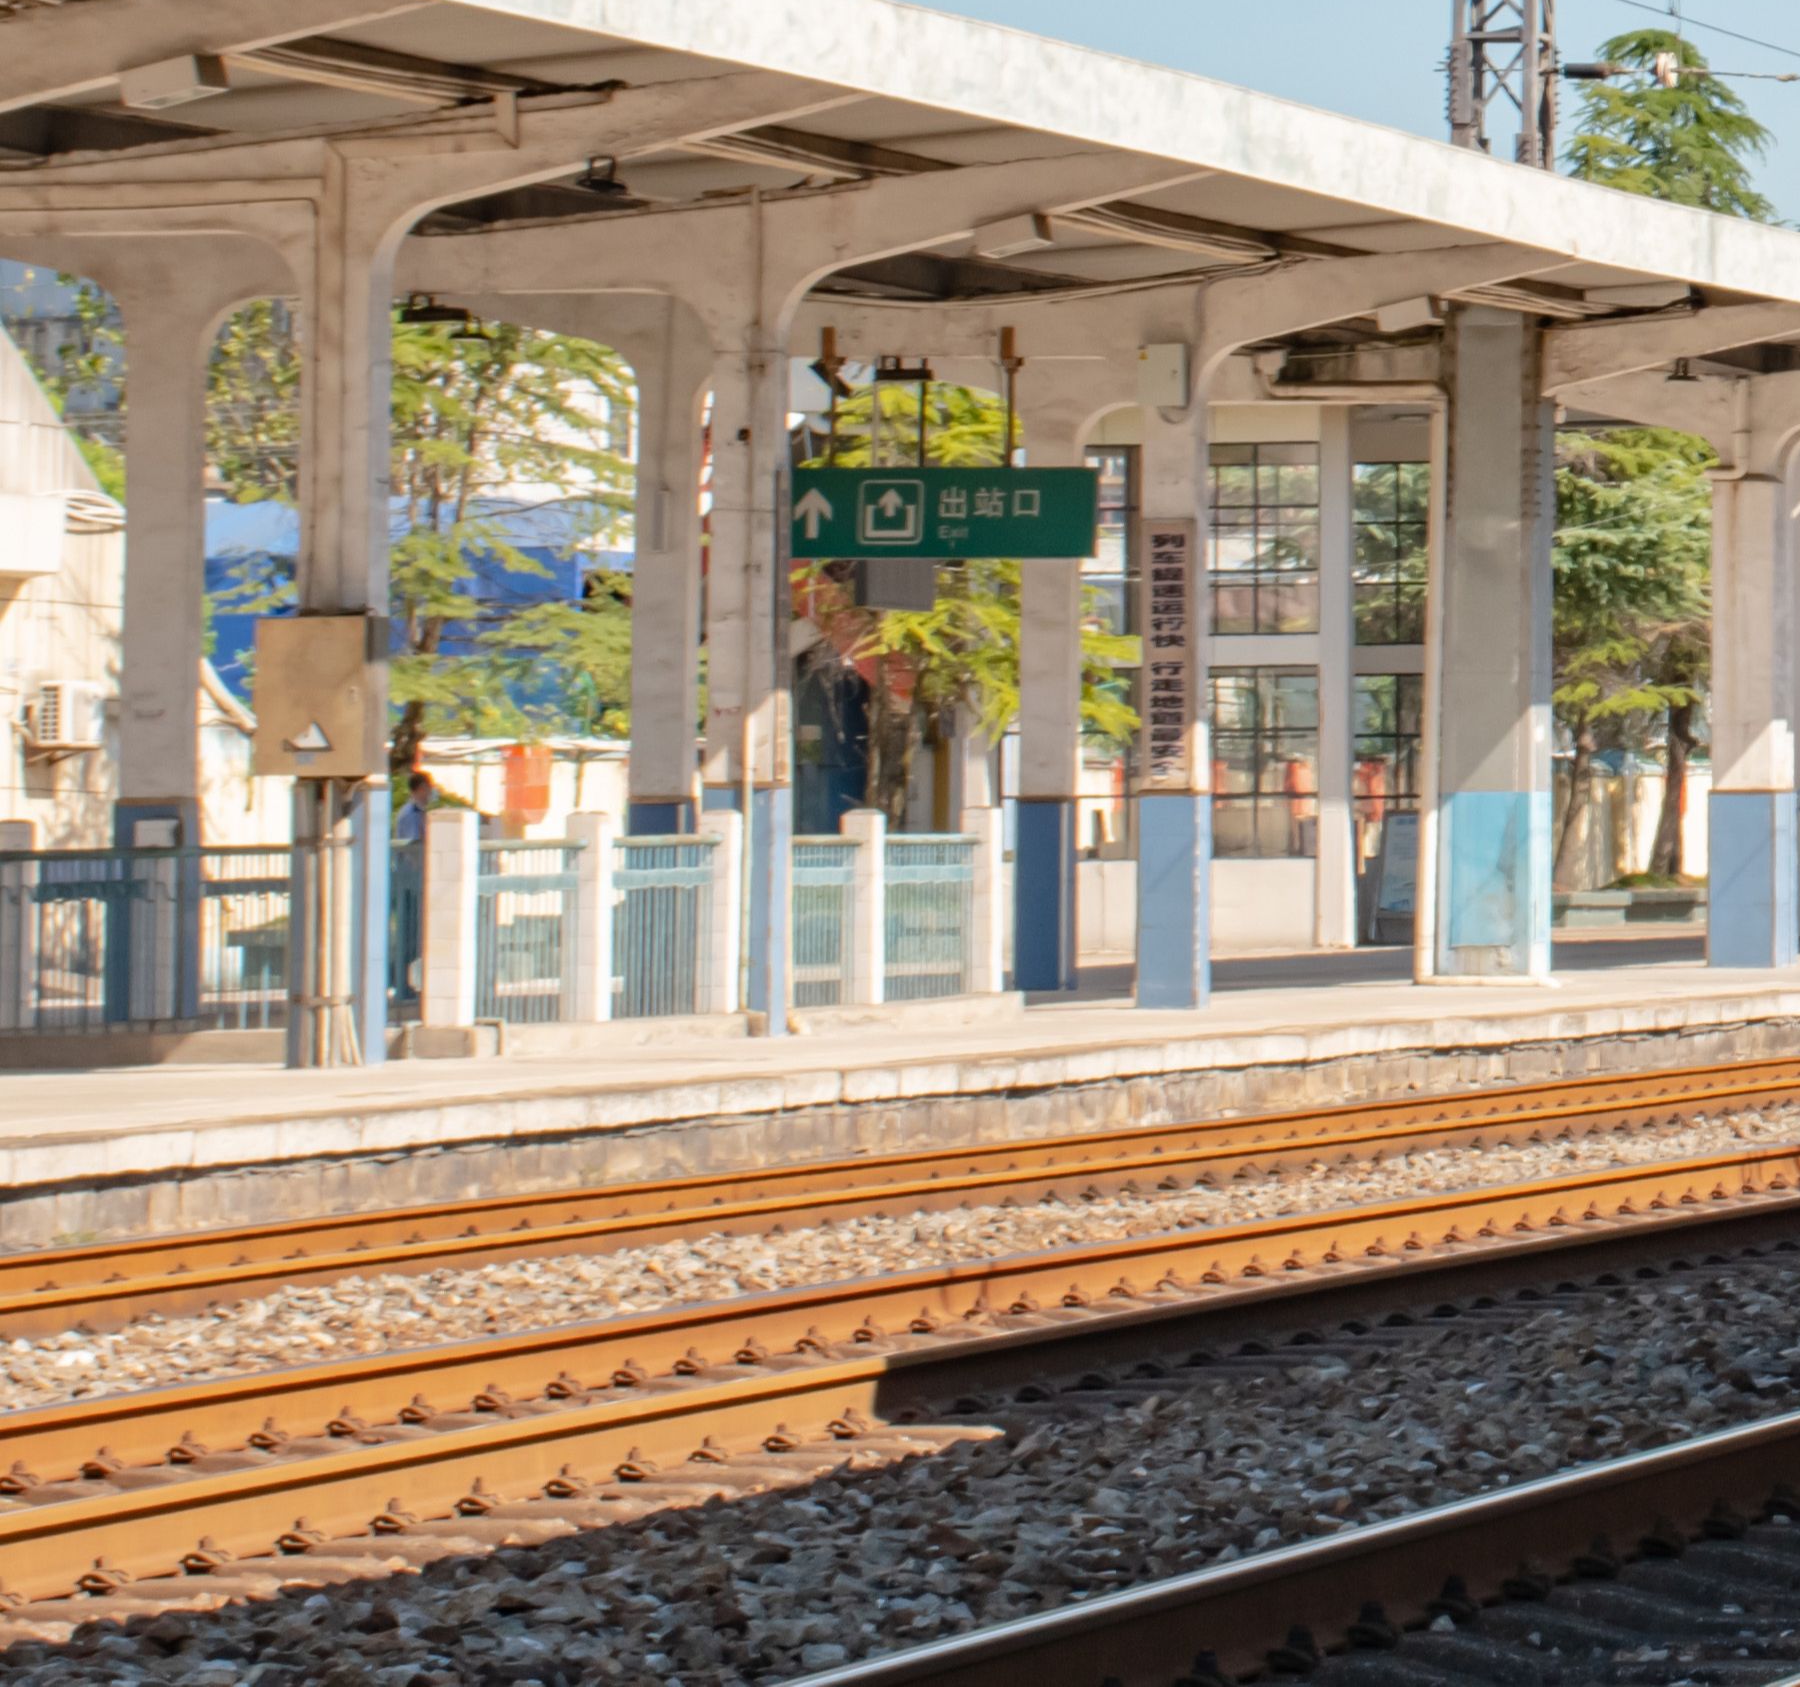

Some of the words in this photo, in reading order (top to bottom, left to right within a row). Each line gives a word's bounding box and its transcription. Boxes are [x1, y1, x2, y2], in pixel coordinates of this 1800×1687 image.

[938, 486, 1040, 519] 出站口
[937, 524, 969, 540] Exit
